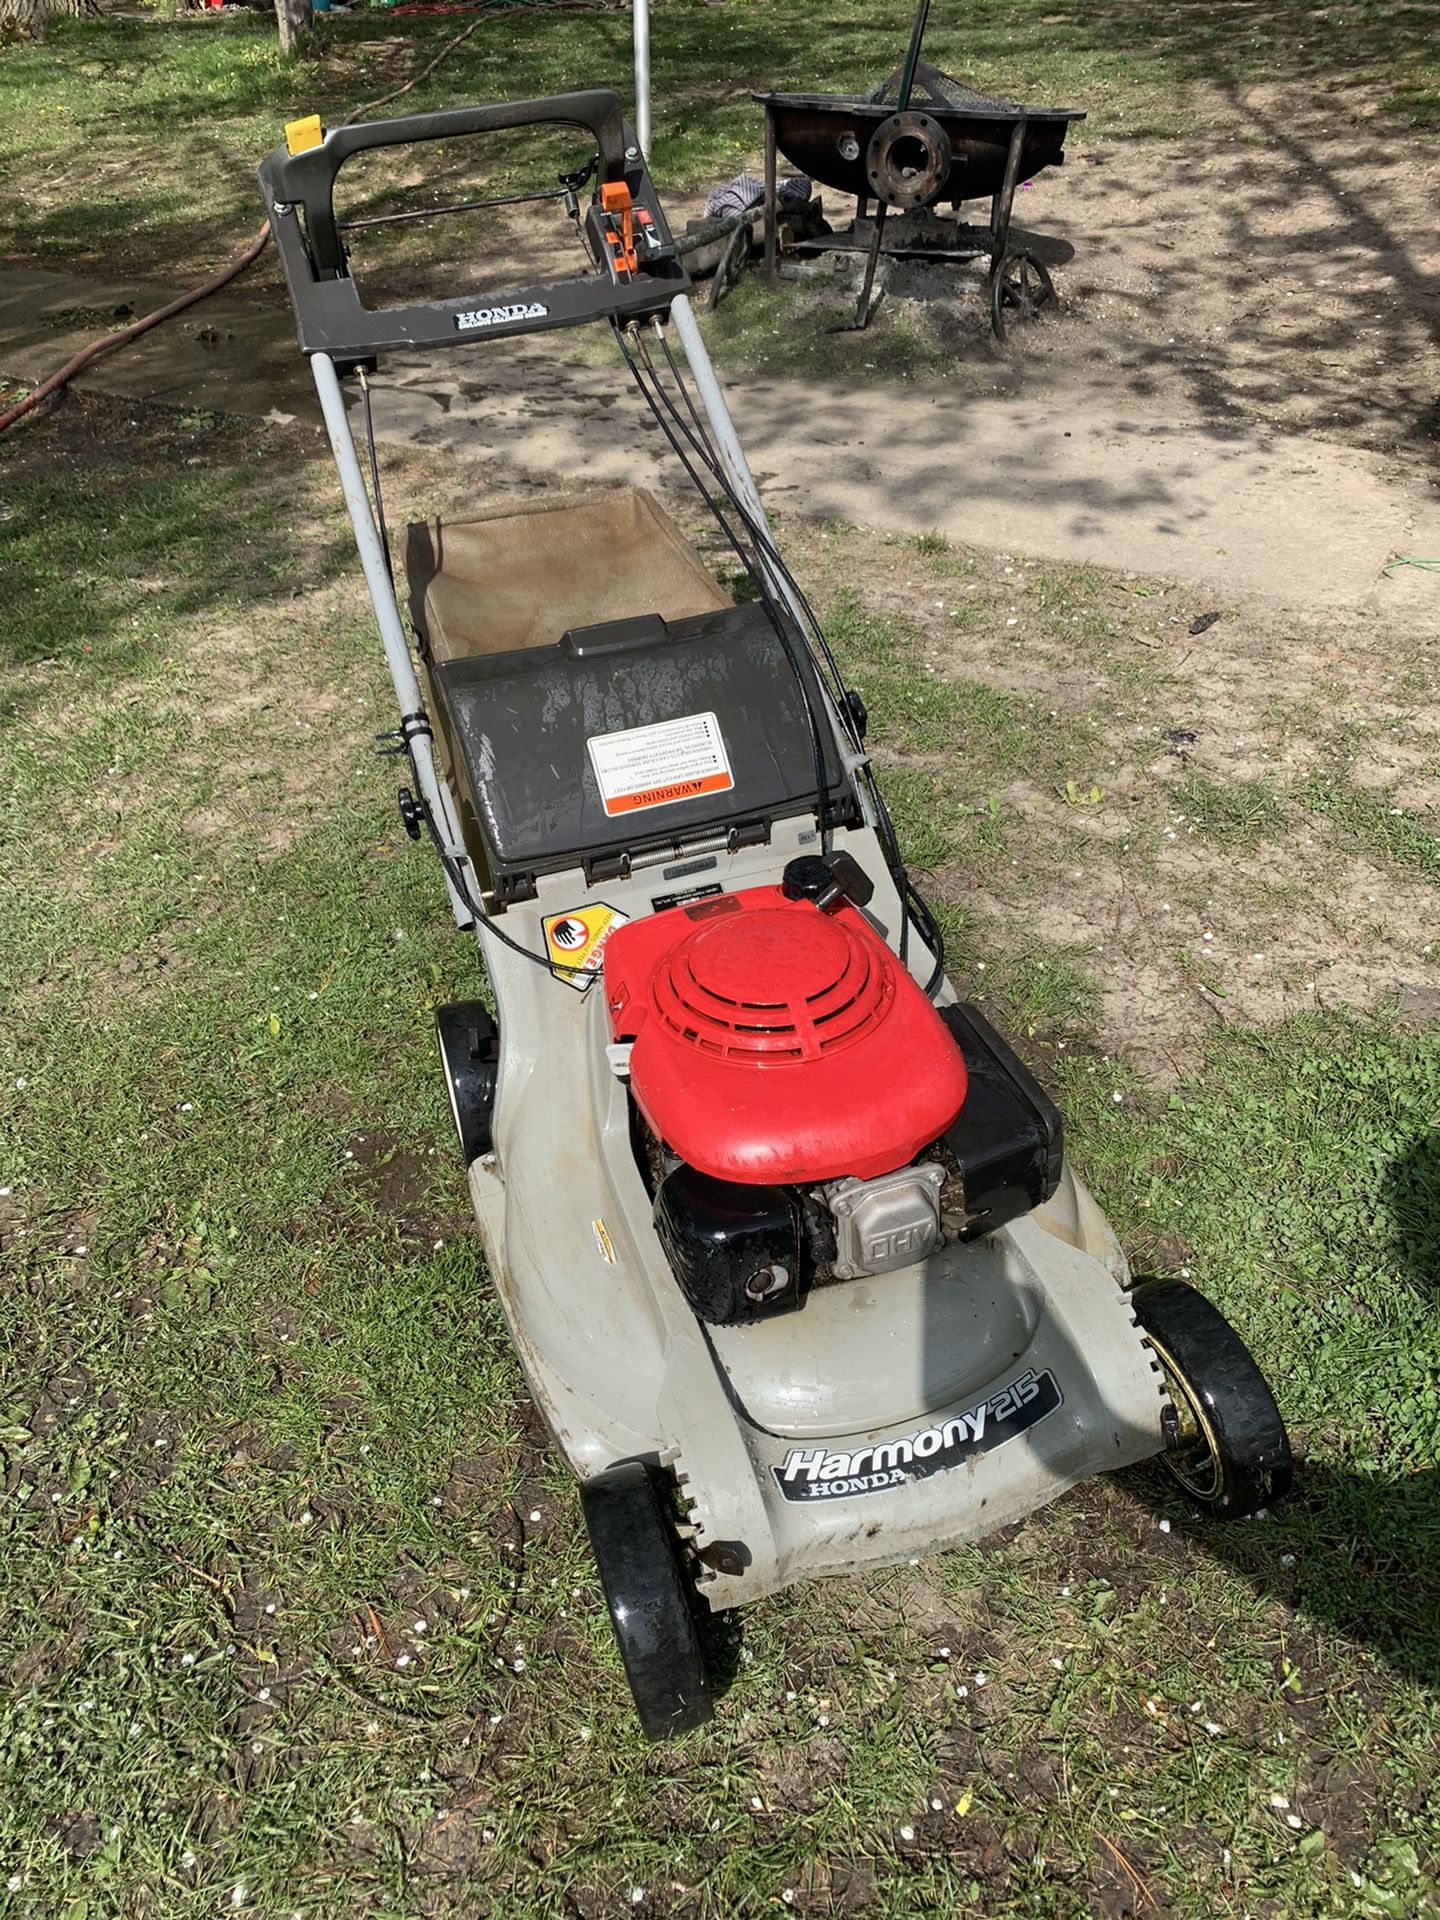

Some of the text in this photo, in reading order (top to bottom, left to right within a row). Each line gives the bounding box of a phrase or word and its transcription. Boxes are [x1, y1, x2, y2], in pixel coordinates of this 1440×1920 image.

[456, 303, 547, 324] HONDA
[632, 783, 691, 805] WARNING
[583, 925, 616, 970] DANGE
[869, 1223, 932, 1260] OHV
[784, 1374, 1040, 1481] Harmony 215
[809, 1467, 906, 1498] HONDA
